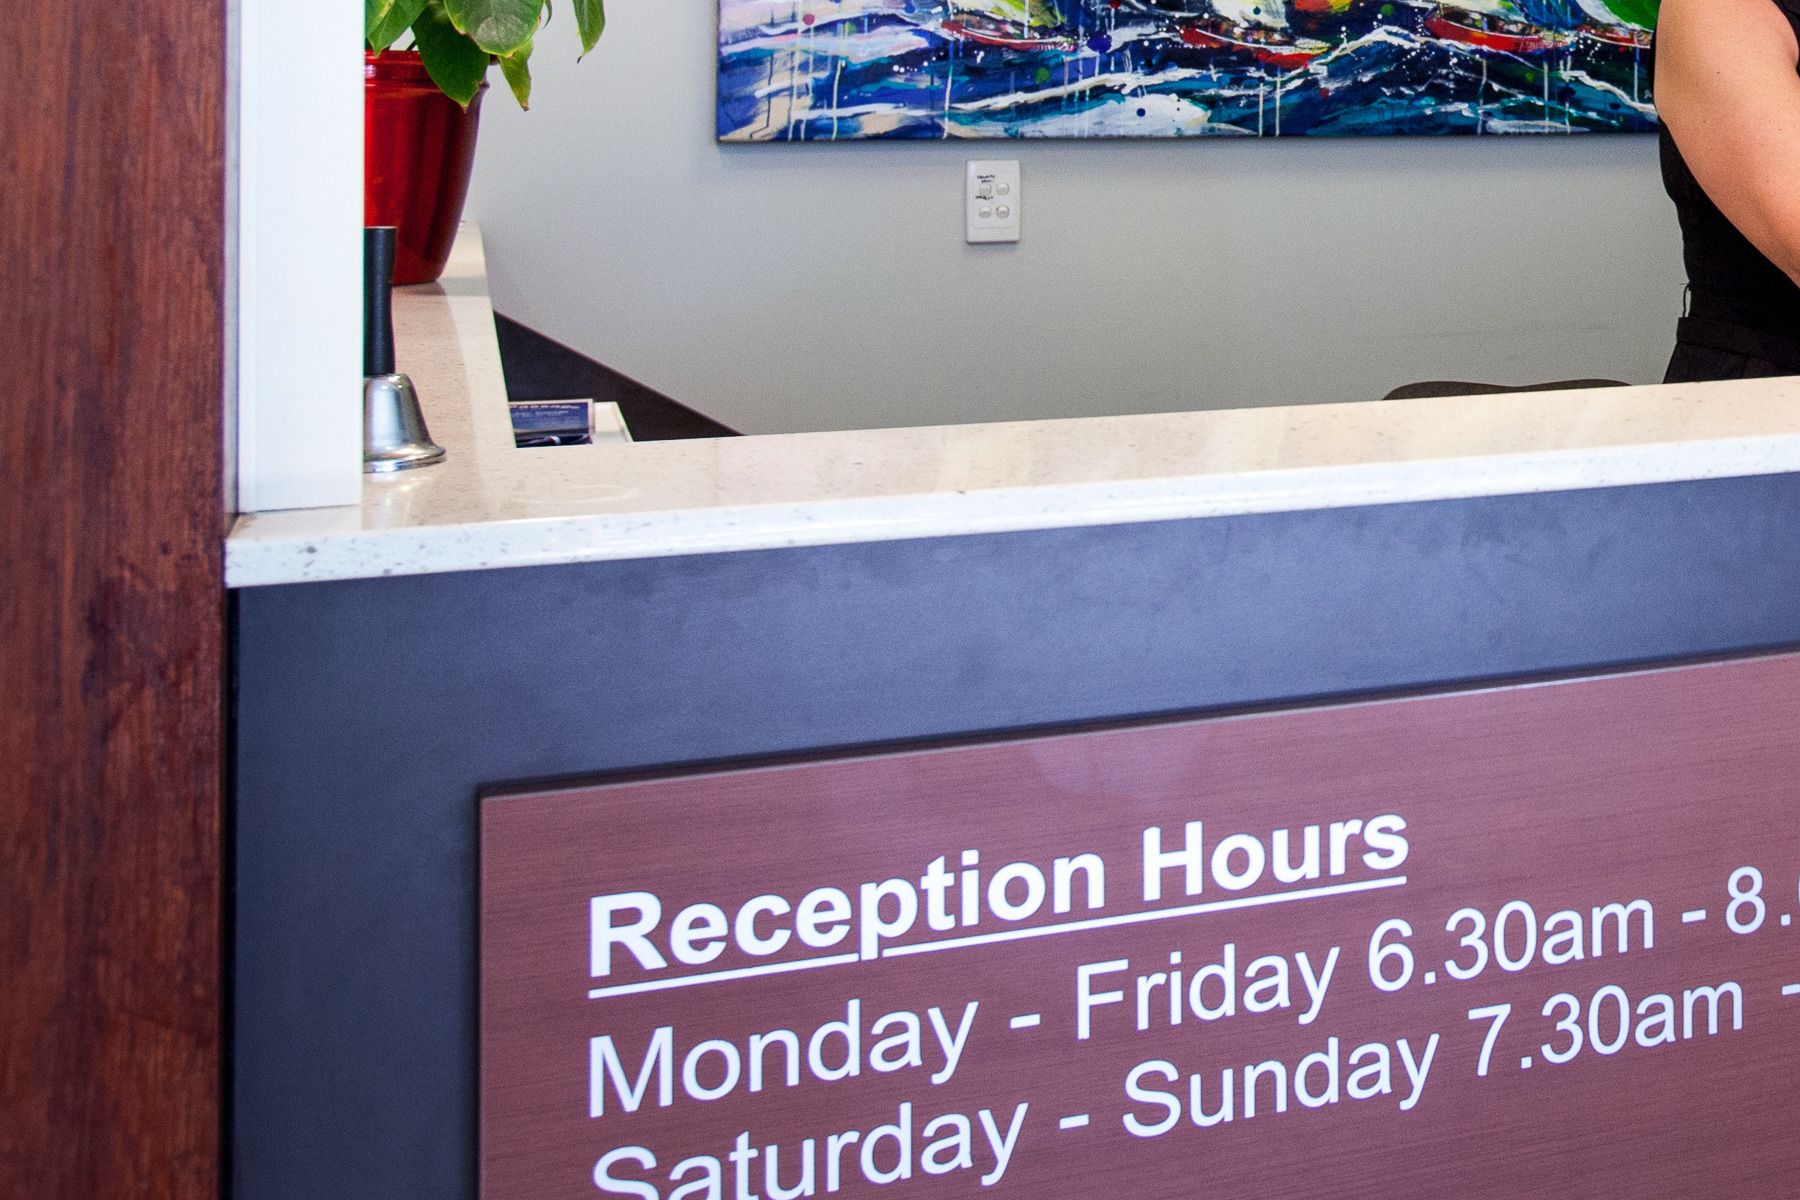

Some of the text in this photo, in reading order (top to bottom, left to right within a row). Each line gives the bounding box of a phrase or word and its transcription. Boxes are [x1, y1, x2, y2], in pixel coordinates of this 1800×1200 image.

[589, 814, 1409, 978] Reception Hours
[590, 999, 980, 1118] Monday
[1077, 942, 1341, 1040] Friday
[1368, 898, 1654, 992] 6.30am
[593, 1102, 1029, 1200] Saturday
[1122, 1033, 1440, 1137] Sunday
[1467, 981, 1743, 1077] 7.30am
